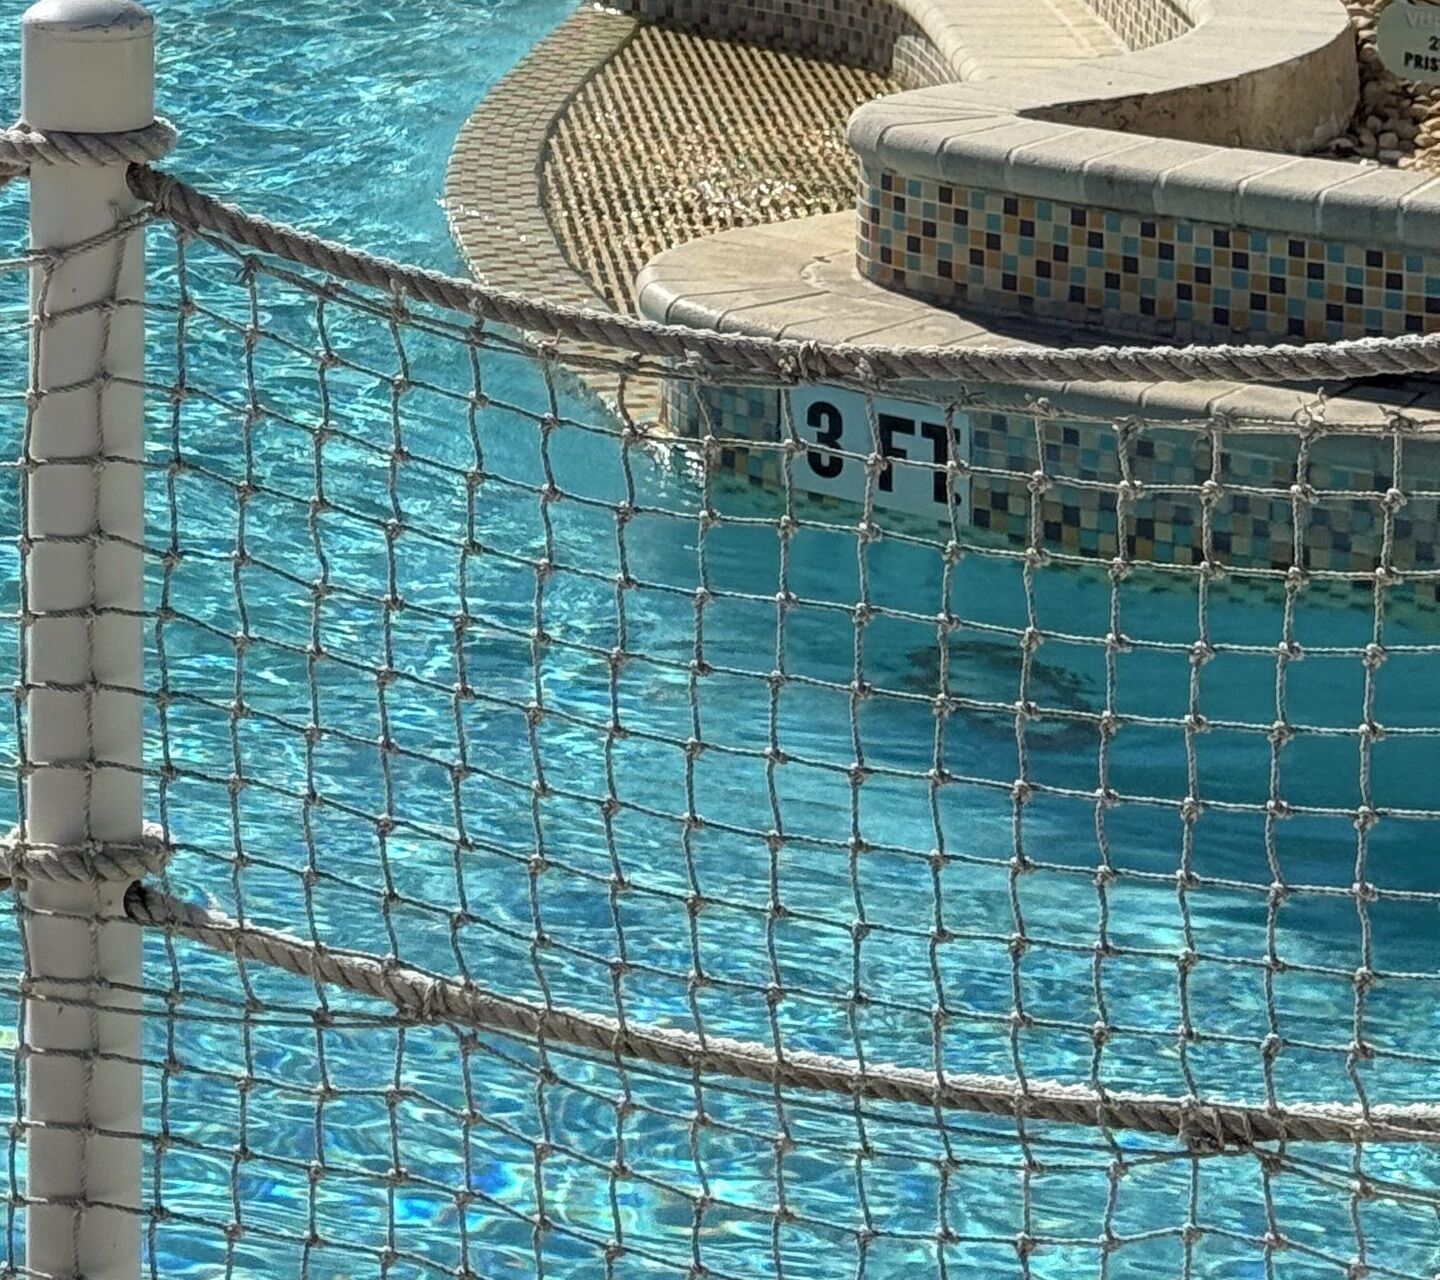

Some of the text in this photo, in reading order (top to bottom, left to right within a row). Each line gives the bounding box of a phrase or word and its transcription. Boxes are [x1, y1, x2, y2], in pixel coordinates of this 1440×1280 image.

[1404, 51, 1440, 72] PRIS
[806, 401, 962, 507] 3 FT.
